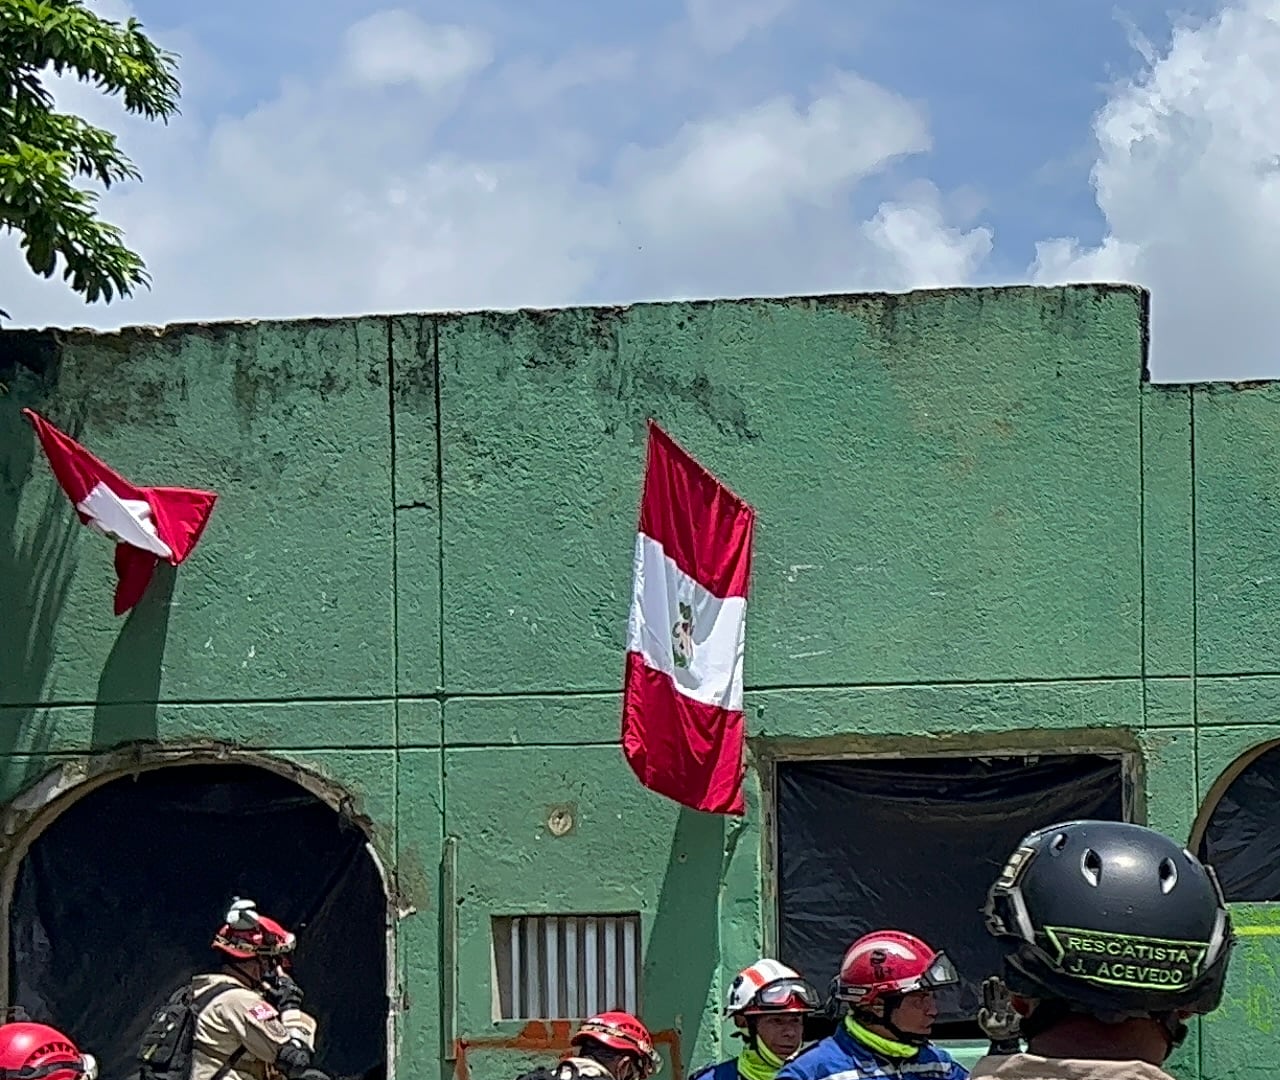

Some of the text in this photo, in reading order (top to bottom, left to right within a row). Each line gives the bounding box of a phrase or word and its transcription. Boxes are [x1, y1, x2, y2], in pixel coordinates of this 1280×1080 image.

[1068, 937, 1190, 963] RESCATISTA
[1070, 958, 1183, 983] J. ACEVEDO
